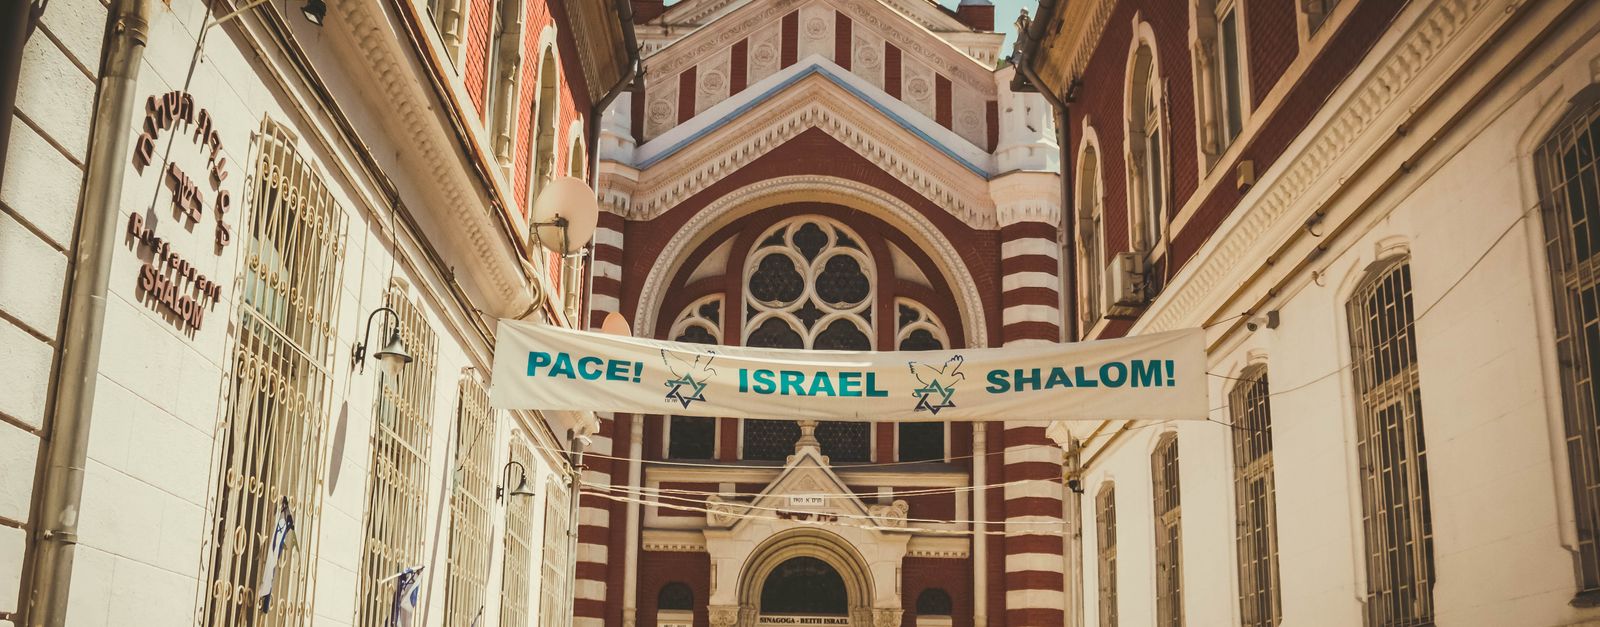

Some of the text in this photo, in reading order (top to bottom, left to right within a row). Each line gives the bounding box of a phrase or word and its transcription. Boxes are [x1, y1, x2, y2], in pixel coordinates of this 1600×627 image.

[140, 263, 205, 331] SHALOM
[526, 350, 1177, 398] PACE! ISRAEL SHALOM!
